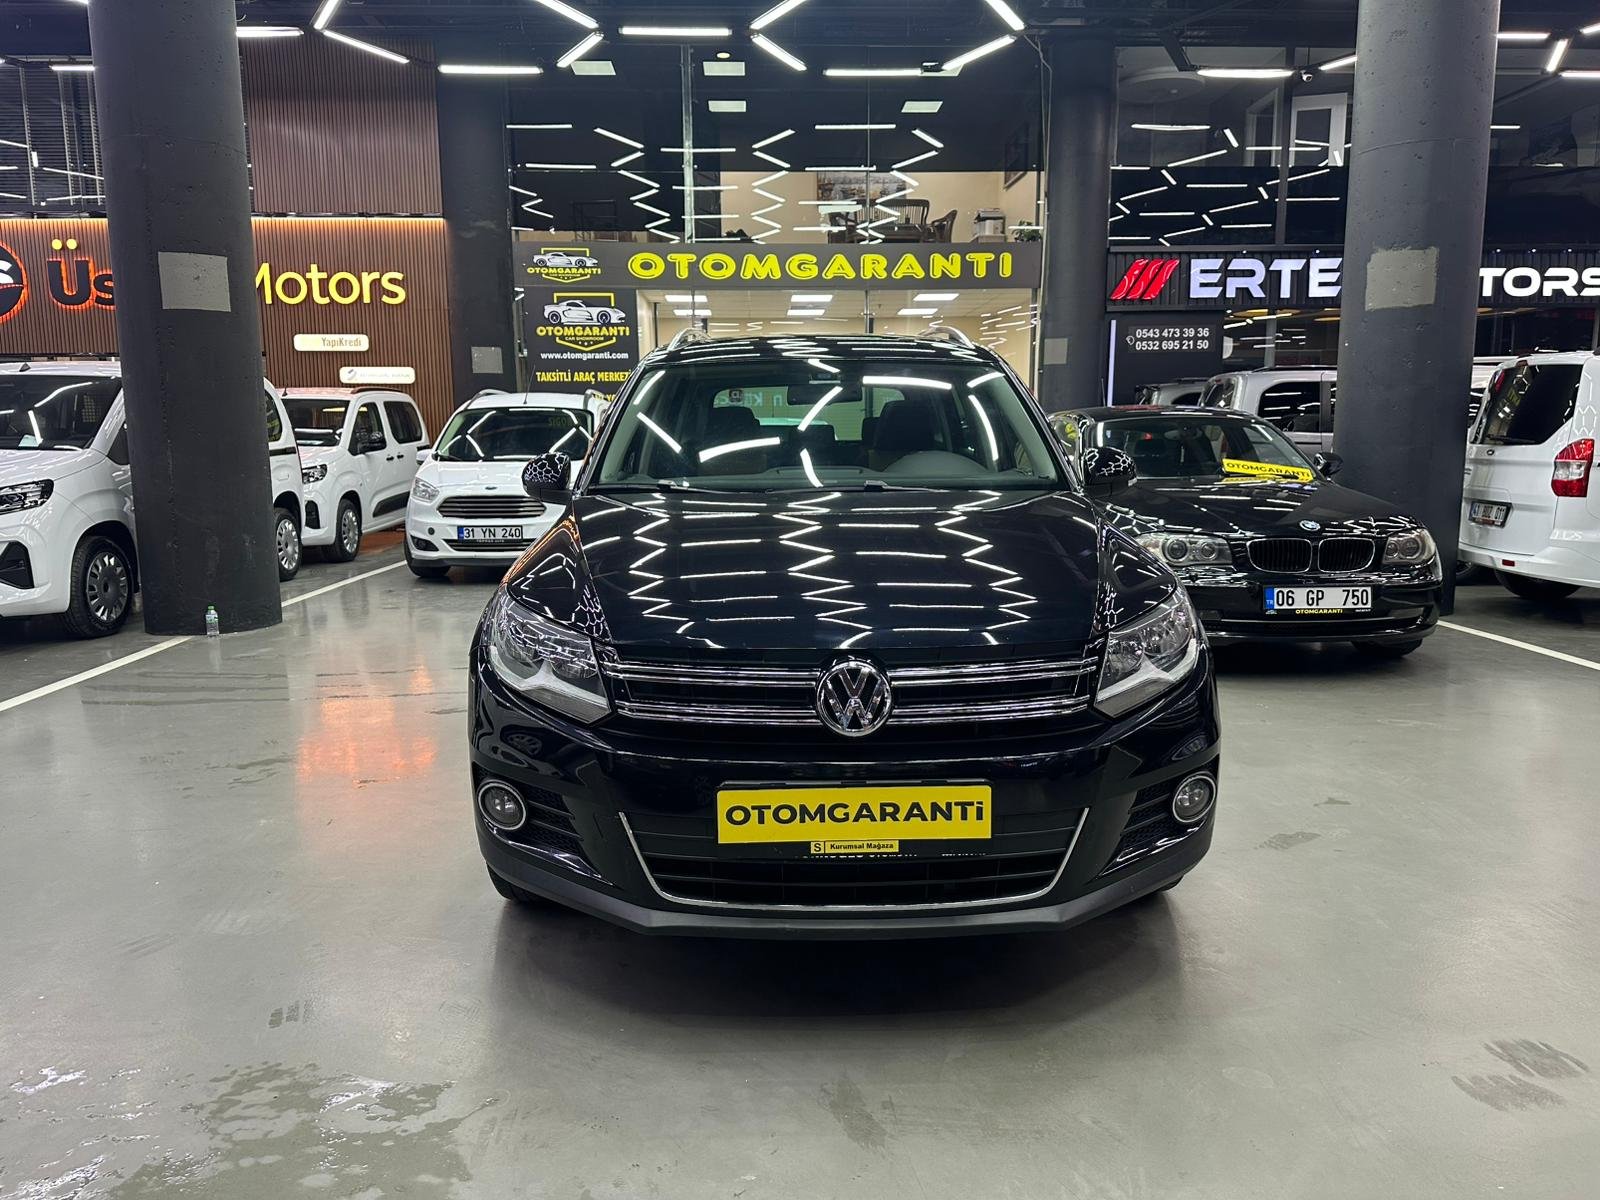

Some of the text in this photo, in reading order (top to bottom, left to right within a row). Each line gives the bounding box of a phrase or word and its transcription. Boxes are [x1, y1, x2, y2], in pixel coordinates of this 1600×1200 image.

[527, 267, 601, 275] OTOMGARANTI
[628, 252, 1013, 280] OTOMGARANTI
[1189, 257, 1343, 299] ERTE
[536, 326, 630, 336] OTOMGARANTI
[1135, 327, 1210, 338] 0543 473 39 36
[1135, 339, 1209, 350] 0532 695 21 50
[540, 351, 629, 361] www.otomgaranti.com
[536, 369, 571, 382] TAKSİTLİ
[573, 371, 595, 384] ARAÇ
[1226, 462, 1310, 477] OTOMGARANTI
[464, 527, 521, 539] 31 YN 240
[1275, 589, 1295, 607] 06
[1306, 589, 1324, 607] GP
[1342, 589, 1369, 606] 750
[866, 842, 894, 850] Mağaza
